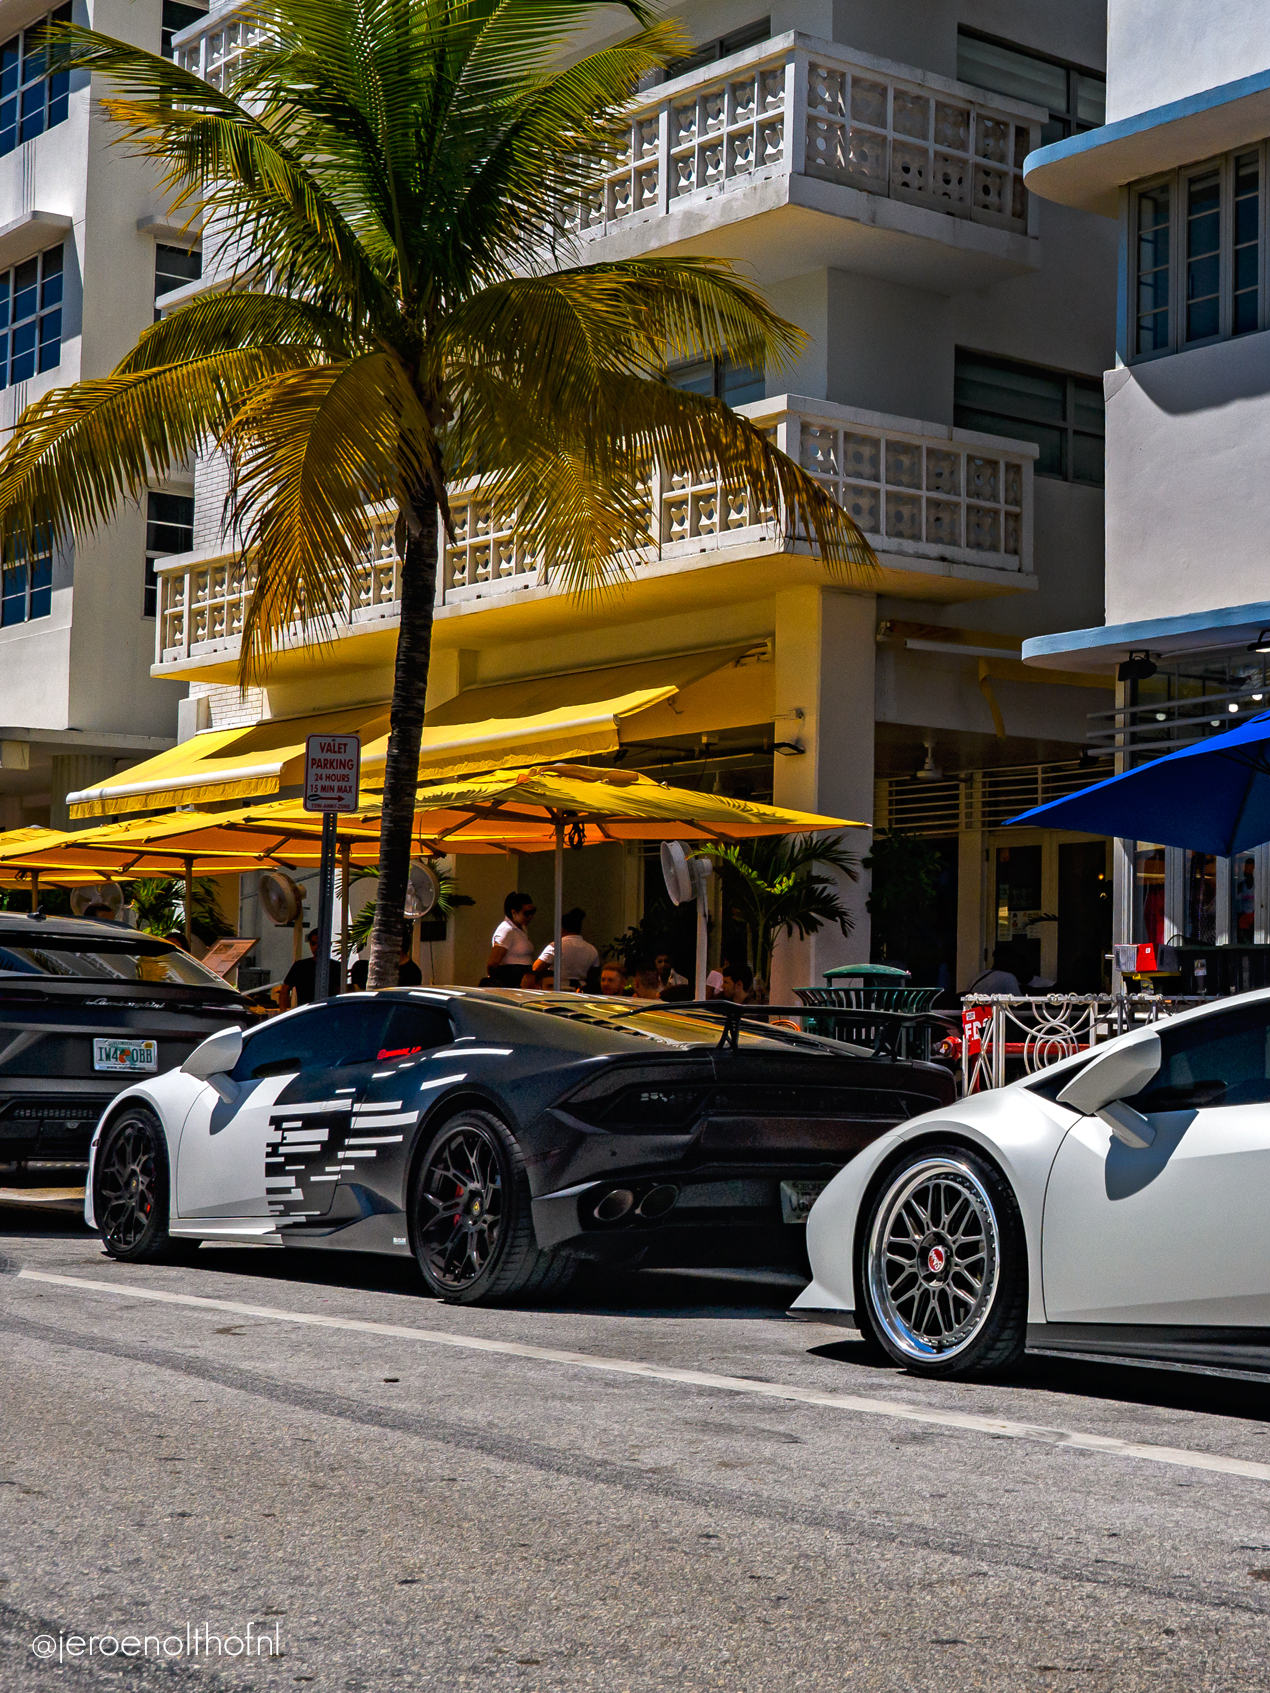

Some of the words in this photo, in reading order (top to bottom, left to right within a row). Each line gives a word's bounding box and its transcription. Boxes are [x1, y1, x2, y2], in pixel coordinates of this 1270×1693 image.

[319, 742, 348, 754] VALET
[310, 758, 354, 770] PARKING
[315, 773, 323, 781] 24
[325, 773, 350, 782] HOURS
[310, 784, 318, 793] 15
[321, 785, 335, 793] MIN
[337, 785, 353, 793] MAX
